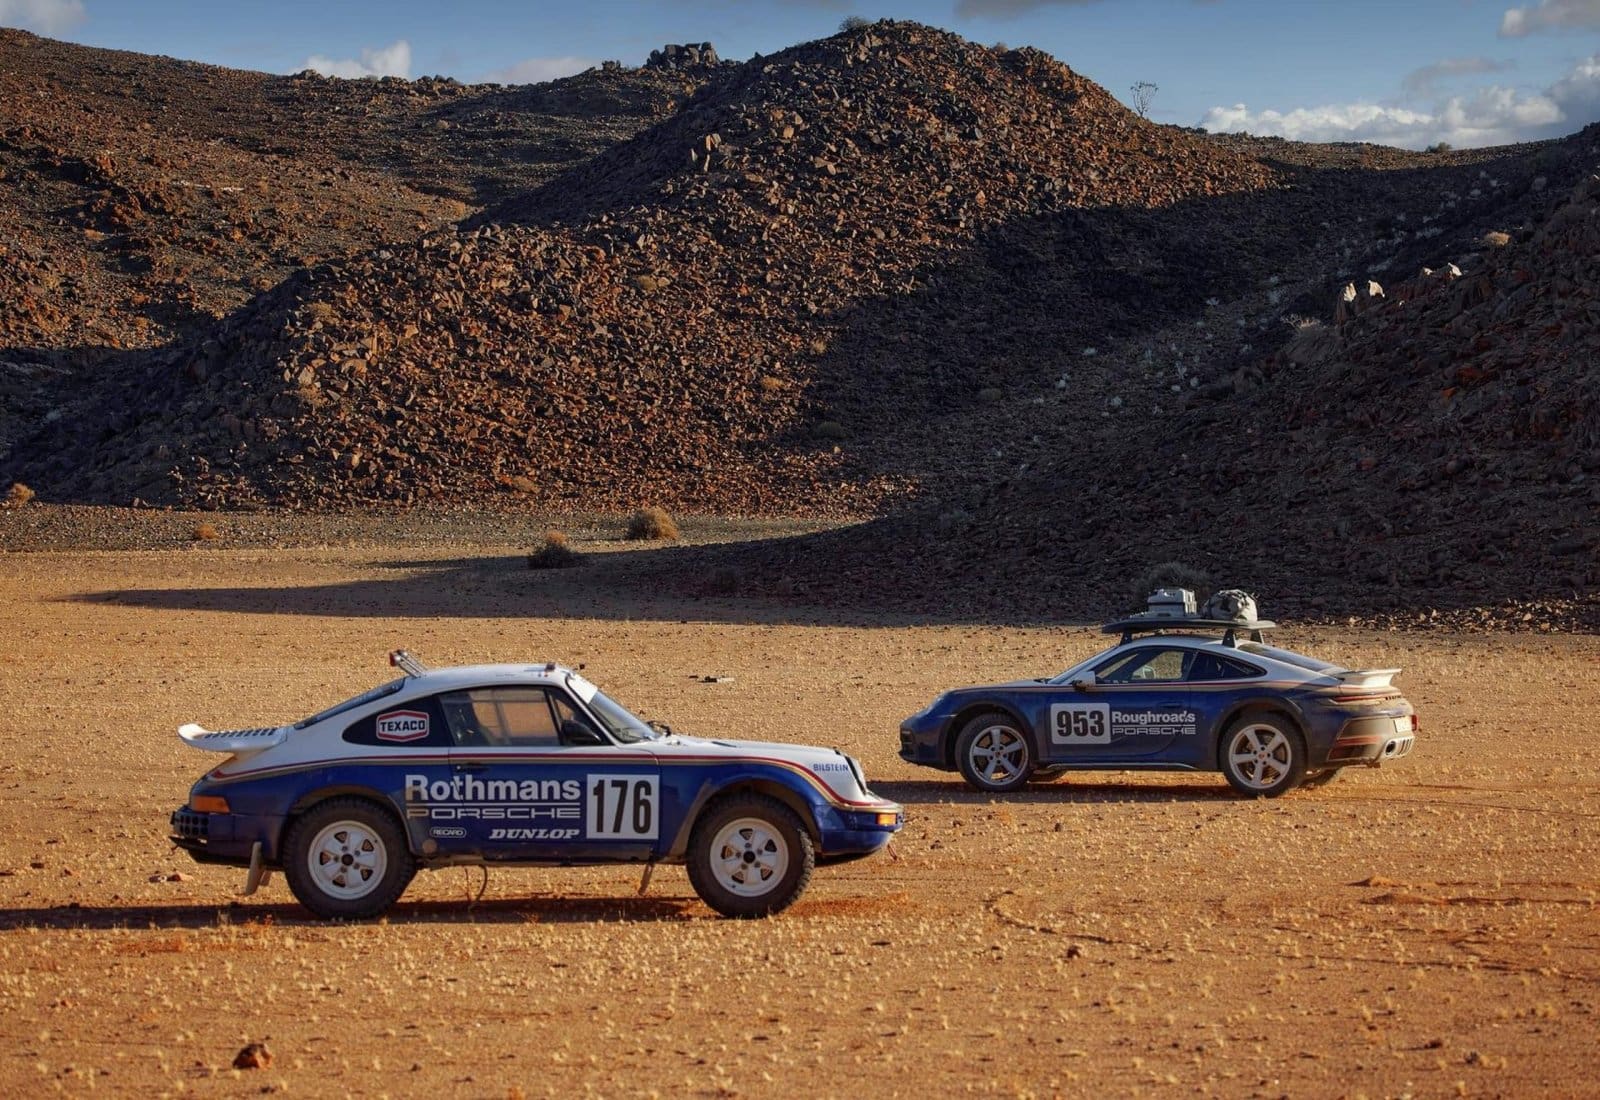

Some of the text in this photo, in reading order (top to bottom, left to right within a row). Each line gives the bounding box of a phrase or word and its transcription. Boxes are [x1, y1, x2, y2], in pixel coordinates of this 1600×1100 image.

[1056, 710, 1105, 737] 953
[1111, 711, 1196, 725] Roughroads
[380, 720, 426, 732] TEXACO
[1112, 727, 1196, 735] PORSCHE
[813, 763, 849, 771] BILSTEIN
[405, 774, 581, 801] Rothmans
[592, 779, 653, 834] 176
[406, 807, 581, 820] PORSCHE
[489, 828, 580, 840] DUNLOP
